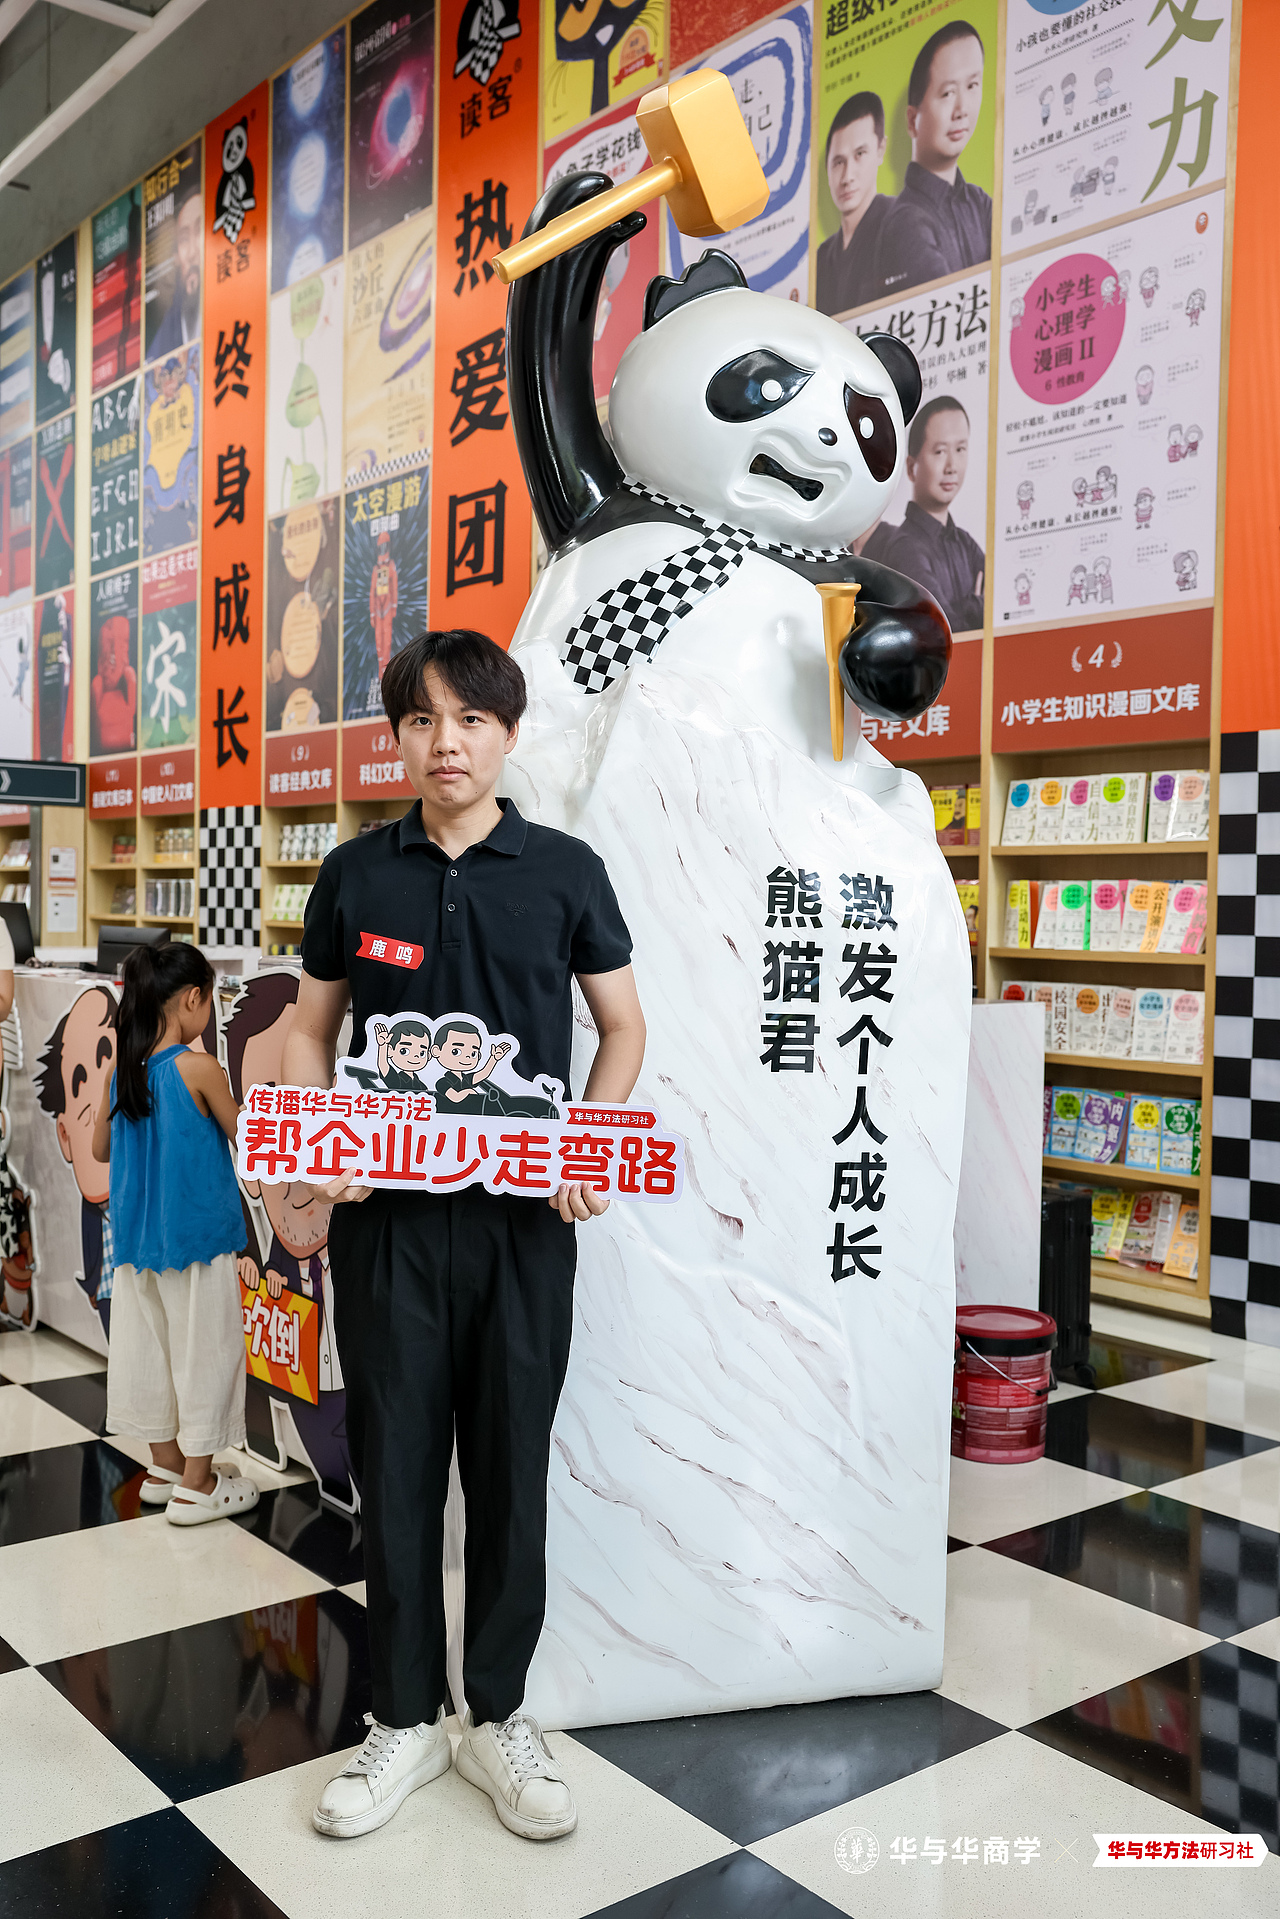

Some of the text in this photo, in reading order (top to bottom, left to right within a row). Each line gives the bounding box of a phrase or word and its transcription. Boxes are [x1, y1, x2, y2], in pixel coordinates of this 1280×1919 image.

[459, 74, 513, 139] 读客
[215, 237, 252, 285] 读客
[353, 263, 384, 306] 沙丘
[1035, 273, 1096, 312] 小学生
[1034, 303, 1096, 341] 心理学
[1034, 341, 1074, 374] 漫画
[352, 474, 421, 525] 太空漫游
[213, 320, 253, 769] 终身成长
[146, 620, 187, 734] 宋
[1088, 644, 1105, 668] 4
[1001, 683, 1201, 727] 小学生知识漫画文库
[269, 767, 332, 793] 读客经典文库
[359, 760, 406, 785] 科幻文库
[759, 865, 824, 1074] 熊猫君
[1054, 989, 1068, 1051] 校园安全
[826, 872, 899, 1283] 激发个人成长
[248, 1089, 432, 1121] 传播华与华方法
[574, 1111, 649, 1125] 华与华方法研习社
[1094, 1101, 1124, 1161] 内驱力
[245, 1117, 677, 1195] 帮企业少走弯路
